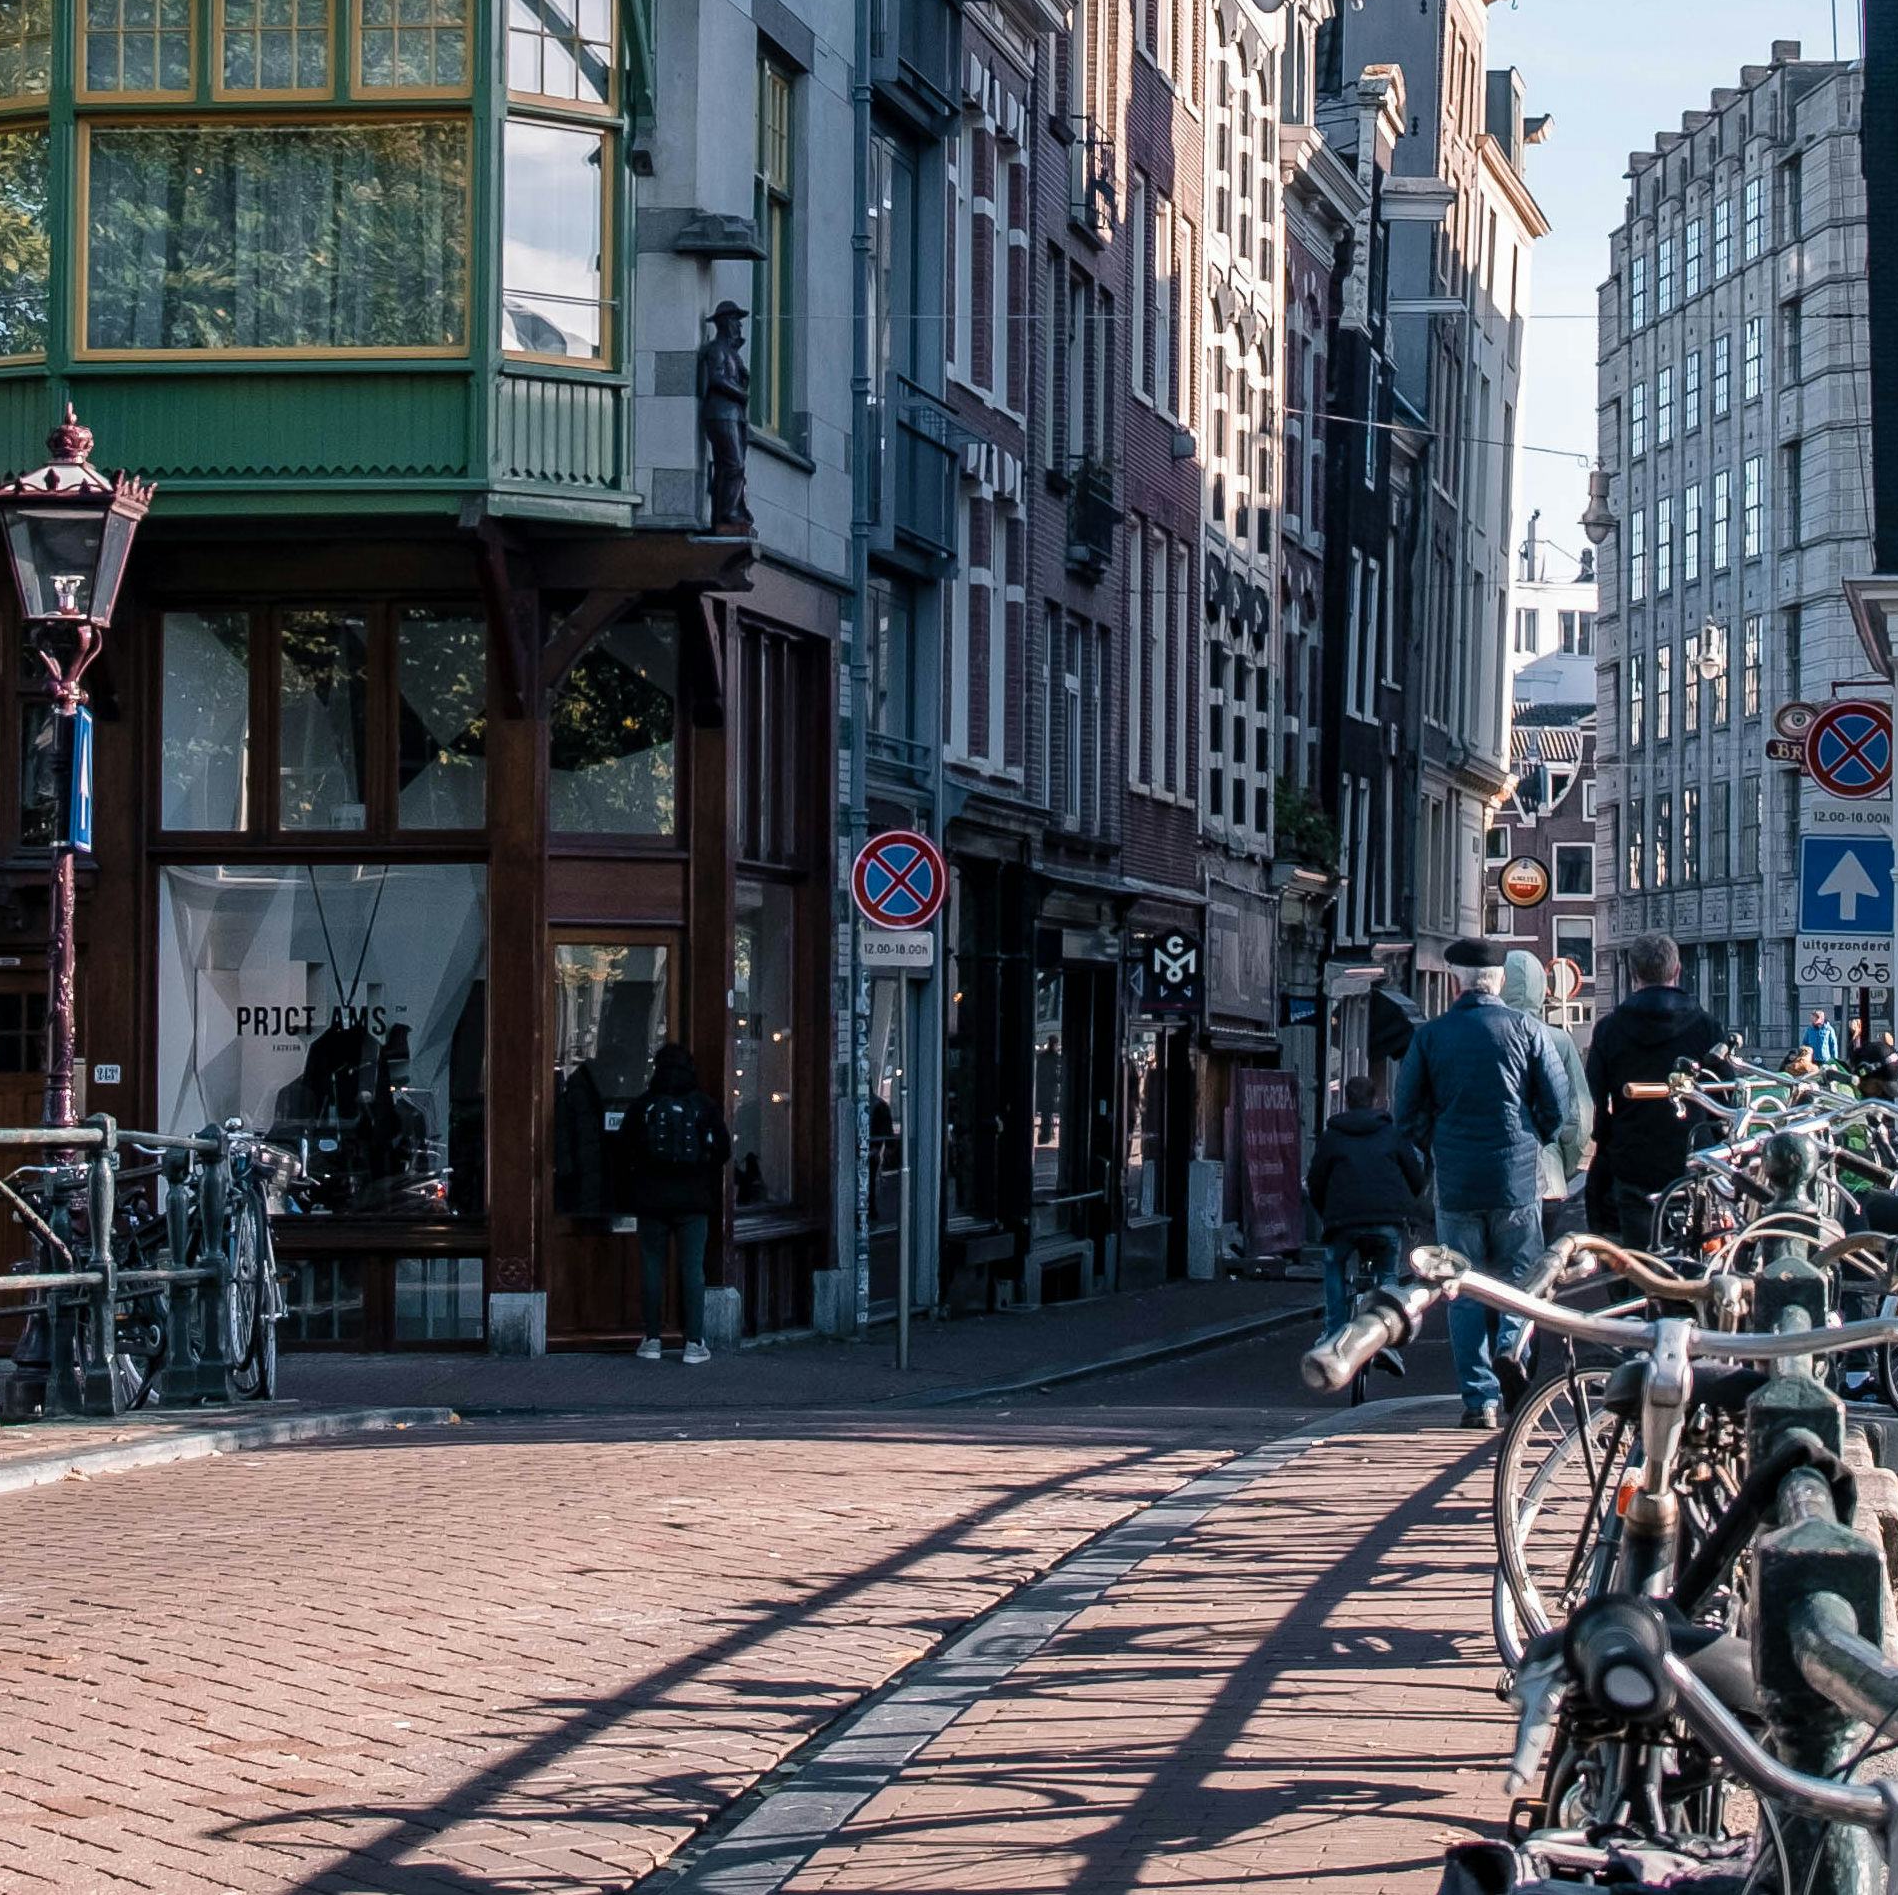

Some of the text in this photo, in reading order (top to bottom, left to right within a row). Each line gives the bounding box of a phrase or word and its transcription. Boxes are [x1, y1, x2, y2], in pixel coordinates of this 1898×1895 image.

[1802, 939, 1891, 953] uitgezonderd
[236, 1006, 316, 1037] PRJCT
[330, 1006, 387, 1036] AMS
